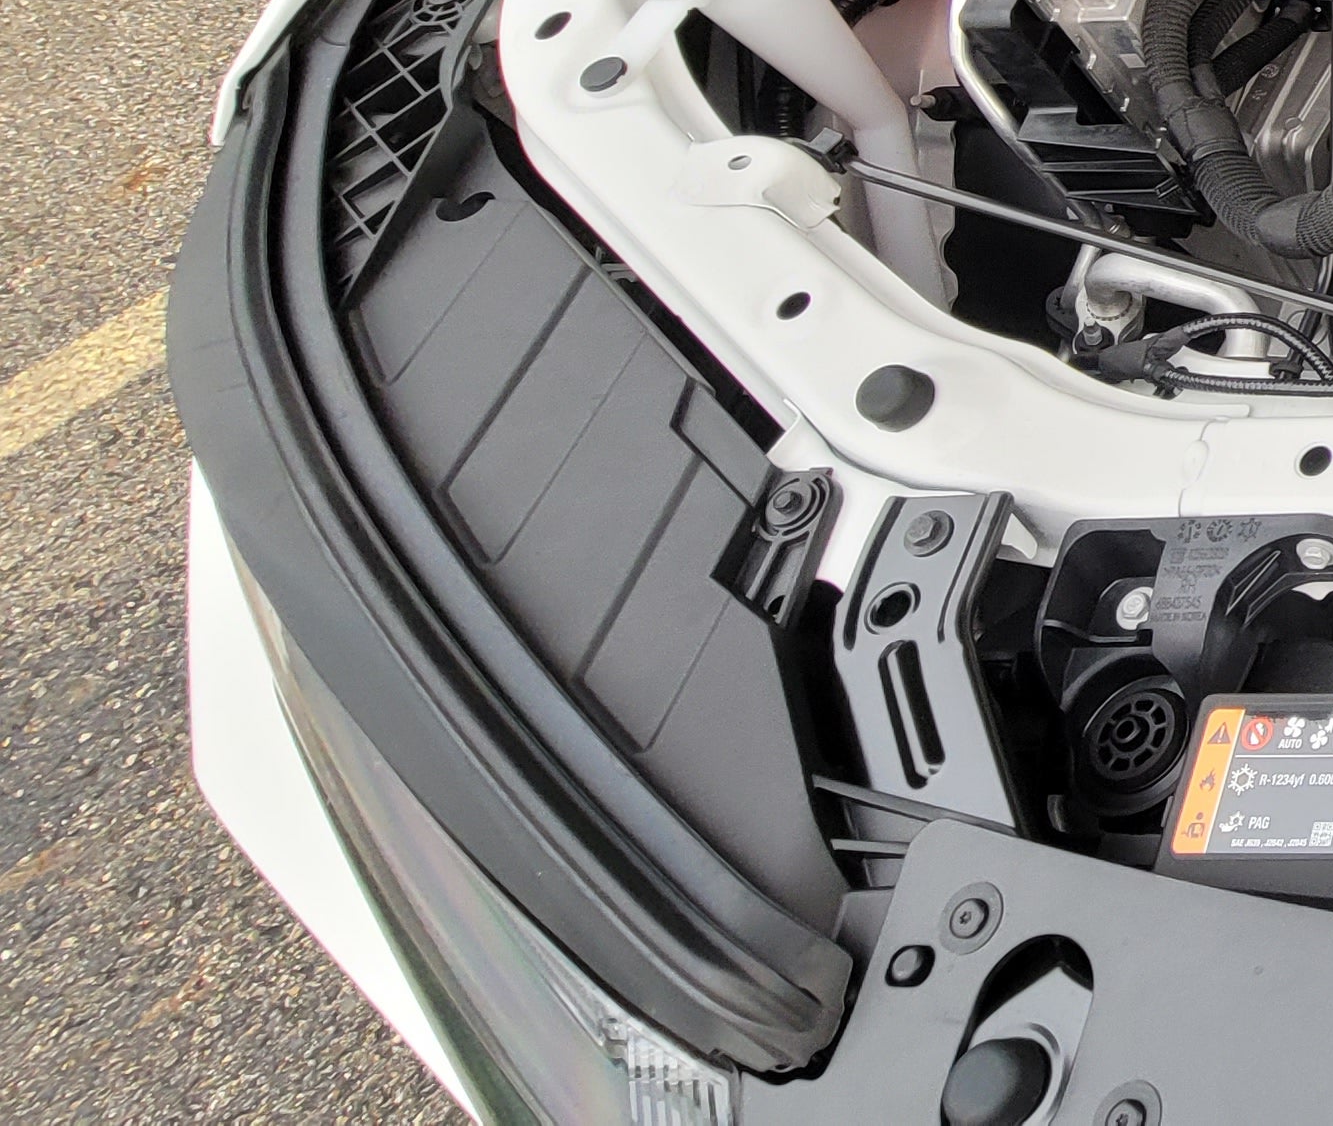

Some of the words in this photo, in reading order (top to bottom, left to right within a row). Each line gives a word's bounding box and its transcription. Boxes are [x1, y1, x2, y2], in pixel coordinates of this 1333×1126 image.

[1278, 739, 1302, 749] AUTO
[1258, 774, 1305, 788] R-1234yf
[1248, 816, 1270, 830] PAG
